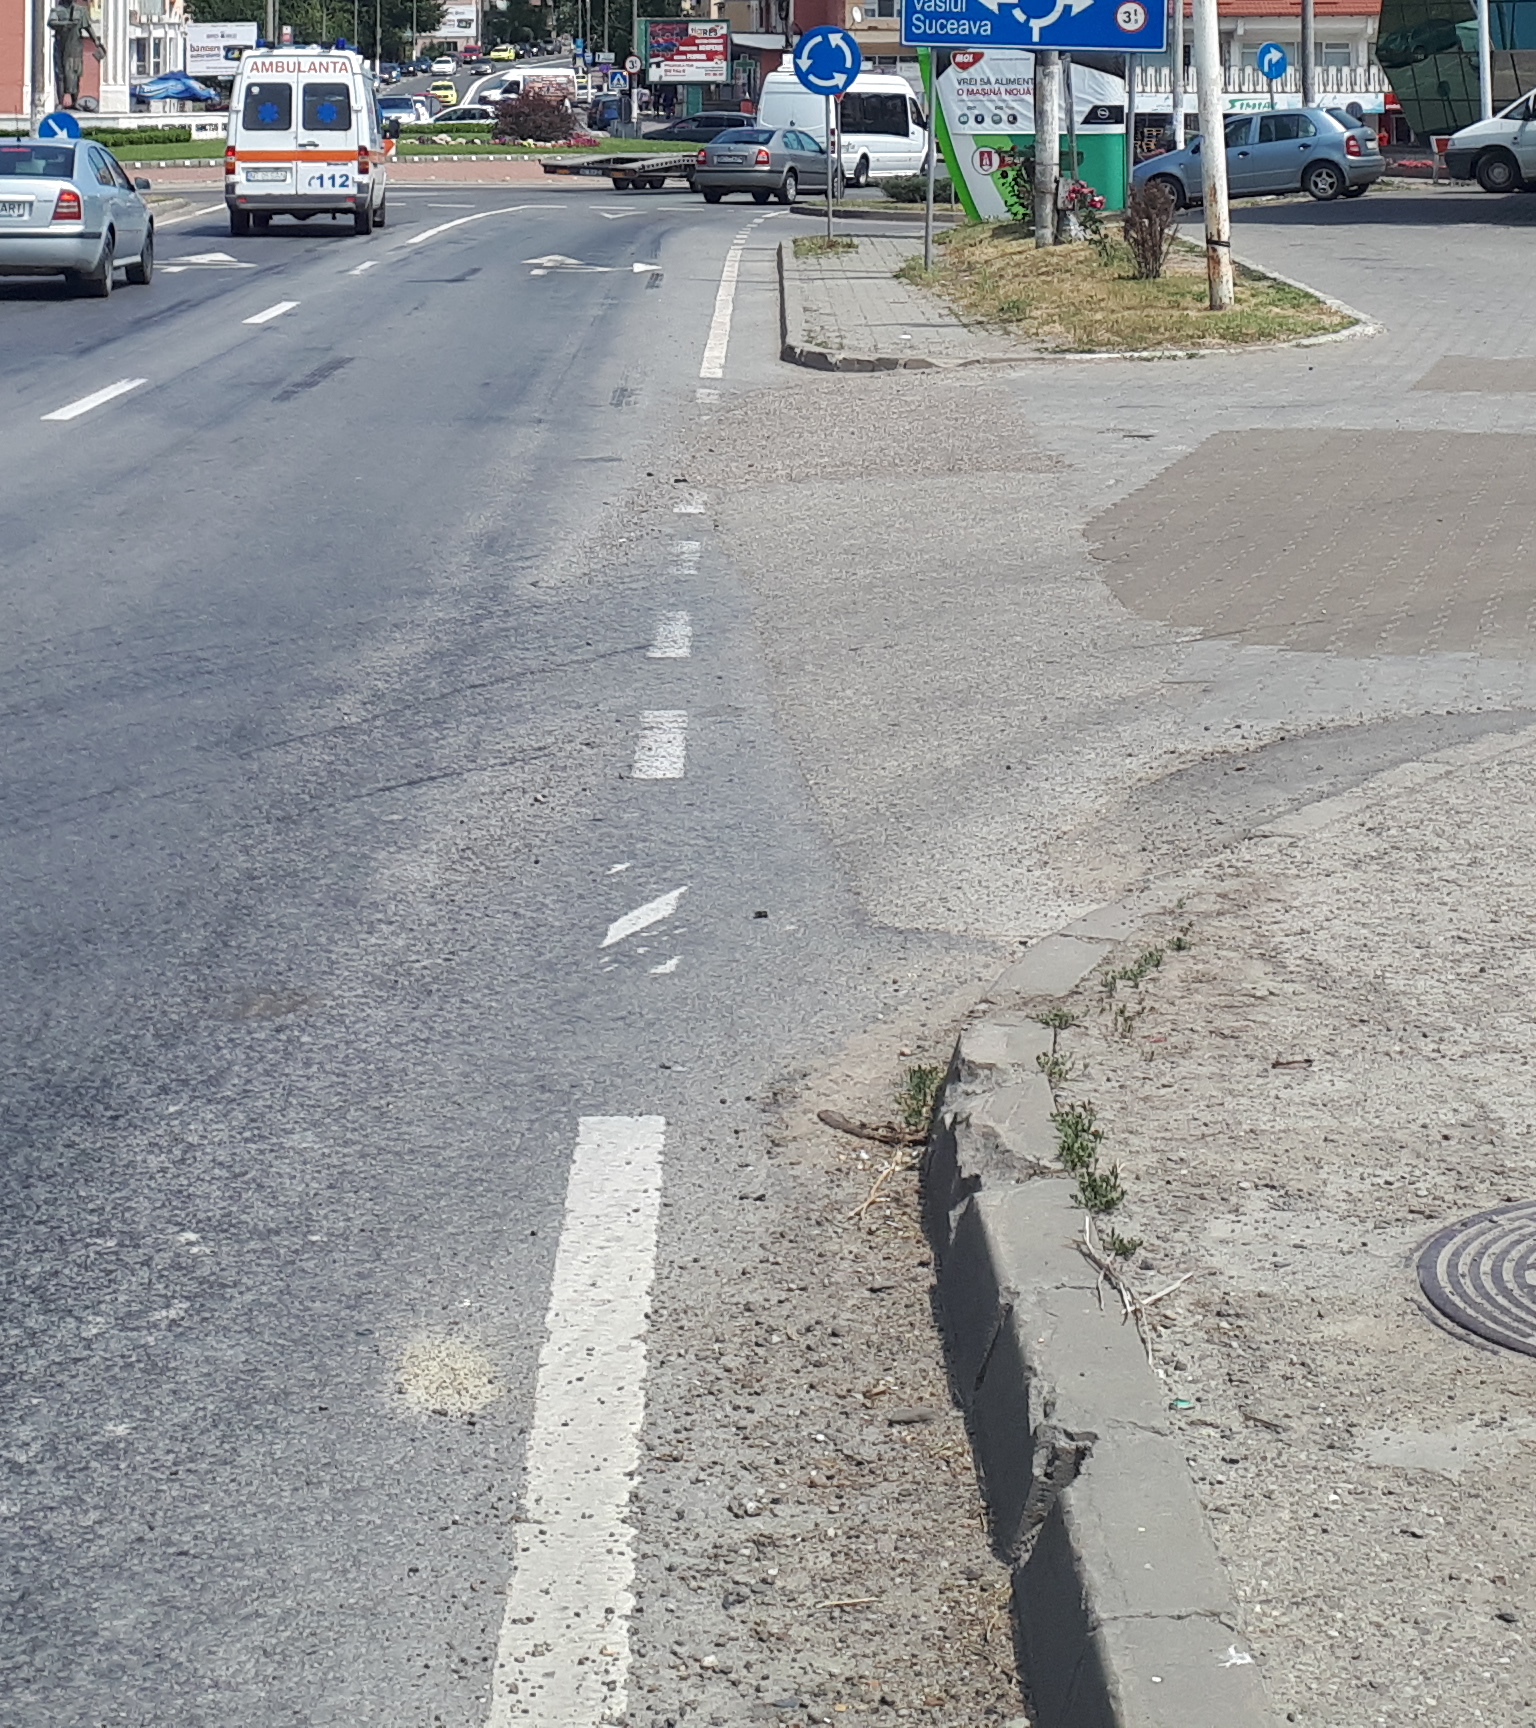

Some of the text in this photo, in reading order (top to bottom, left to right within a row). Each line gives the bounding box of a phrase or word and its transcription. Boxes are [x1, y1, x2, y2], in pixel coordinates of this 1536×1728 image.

[912, 14, 991, 36] Suceava
[955, 54, 974, 63] MOL
[249, 60, 349, 74] AMBULANTA
[316, 174, 350, 188] 112
